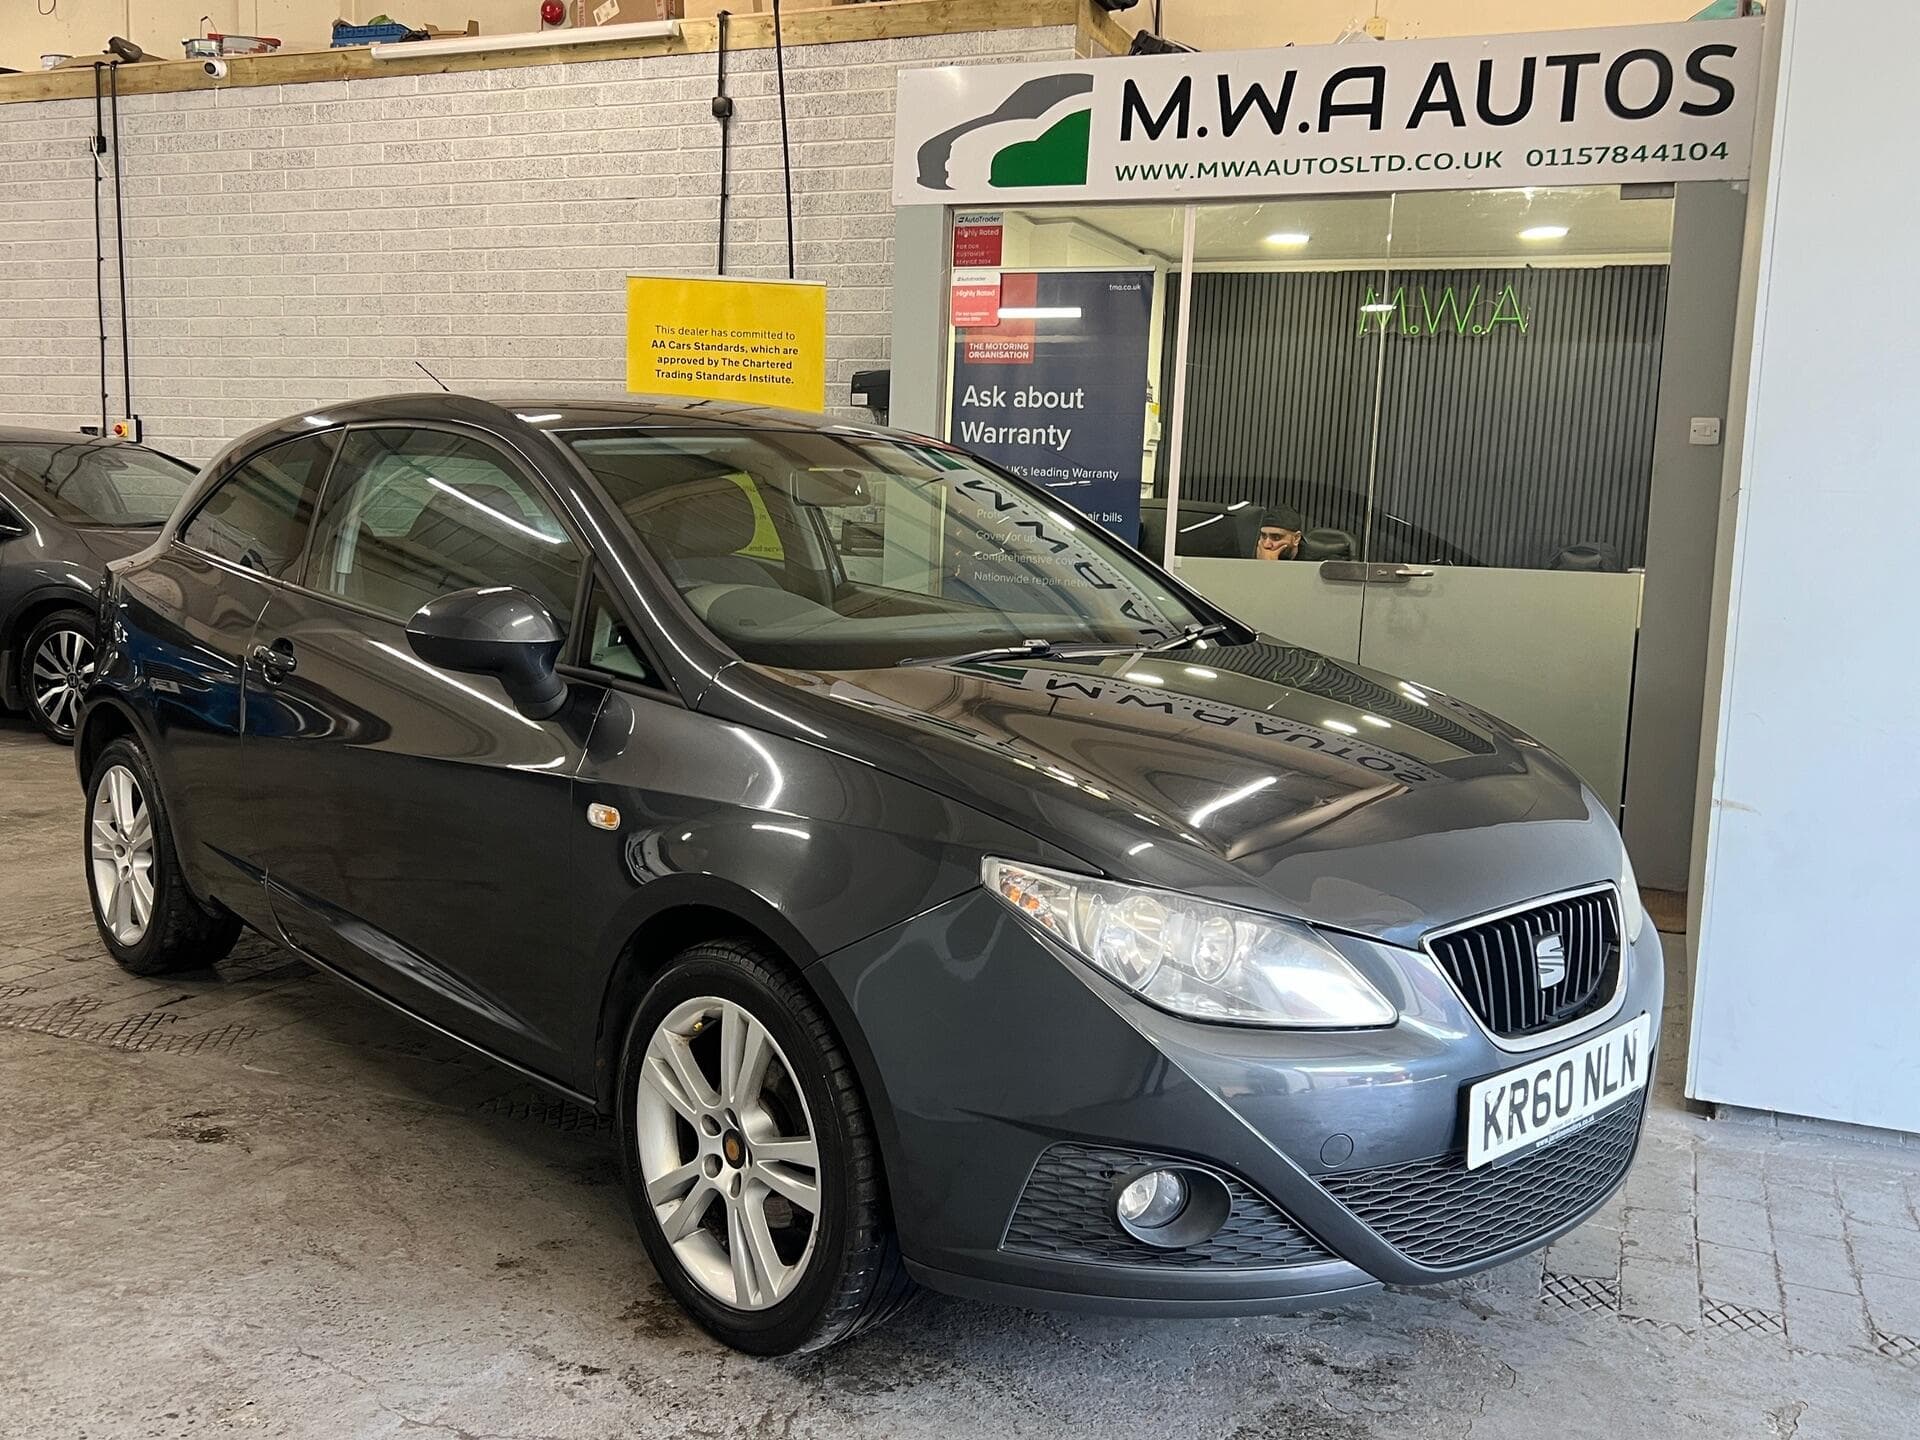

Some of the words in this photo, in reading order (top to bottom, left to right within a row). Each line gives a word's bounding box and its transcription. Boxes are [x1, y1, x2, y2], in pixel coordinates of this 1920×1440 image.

[1120, 65, 1386, 141] M.W.A
[1405, 43, 1738, 129] AUTOS
[1115, 150, 1502, 181] WWW.MWAAUTOSLTD.CO.UK
[1525, 141, 1730, 168] 01157844104
[1359, 284, 1527, 336] M.W.A
[655, 325, 676, 335] This
[678, 326, 709, 337] dealer
[711, 327, 728, 337] has
[730, 328, 783, 340] committed
[786, 331, 796, 341] to
[651, 339, 666, 349] AA
[668, 340, 692, 350] Cars
[694, 341, 748, 354] Standards,
[750, 344, 780, 355] which
[782, 347, 799, 355] are
[968, 342, 984, 350] THE
[985, 342, 1029, 351] MOTORING
[657, 356, 705, 367] approved
[707, 356, 720, 368] by
[721, 357, 740, 368] The
[742, 358, 793, 370] Chartered
[968, 351, 1029, 359] ORGANISATION
[655, 369, 693, 381] Trading
[695, 371, 747, 383] Standards
[749, 373, 794, 385] Institute.
[961, 385, 1007, 408] Ask
[1013, 386, 1085, 410] about
[960, 421, 1072, 451] Warranty
[1030, 466, 1070, 479] leading
[1072, 467, 1119, 481] Warranty
[1102, 512, 1123, 523] bills
[975, 551, 1053, 564] Comprehensive
[974, 571, 1029, 584] Nationwide
[1032, 574, 1061, 587] repair
[1483, 1059, 1574, 1152] KR60
[1583, 1028, 1638, 1108] NLN
